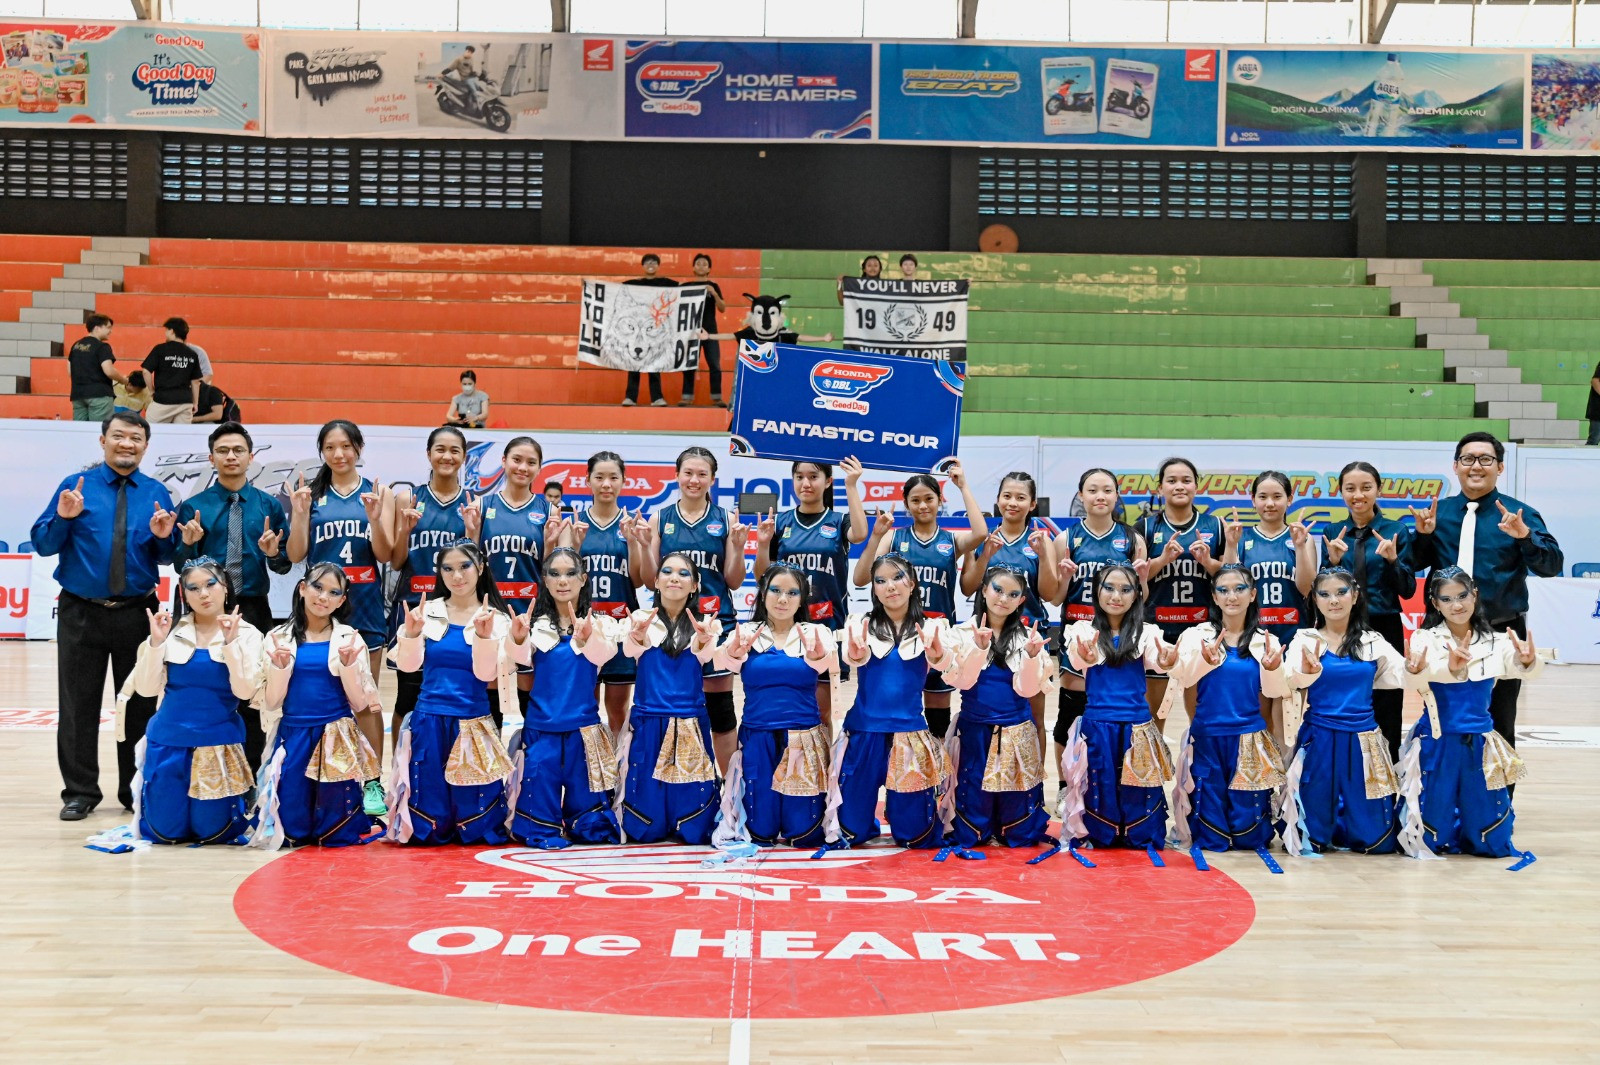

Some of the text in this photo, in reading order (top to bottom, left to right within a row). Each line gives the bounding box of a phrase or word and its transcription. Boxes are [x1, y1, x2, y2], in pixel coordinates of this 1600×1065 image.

[155, 34, 182, 46] Good
[183, 36, 204, 50] Day
[153, 53, 171, 65] It's
[288, 60, 304, 69] PAKE
[137, 63, 215, 84] Good Day
[1236, 63, 1258, 73] AQUA
[307, 74, 325, 85] GAYA
[325, 72, 348, 83] MAKIN
[659, 81, 680, 91] DBL
[725, 74, 794, 87] HOME
[153, 81, 200, 100] Time!
[725, 88, 858, 101] DREAMERS
[1376, 82, 1400, 96] AQUA
[662, 102, 682, 111] Good
[682, 103, 699, 113] Day
[1271, 105, 1486, 117] DINGIN ALAMINYA ADEMIN KAMU
[857, 278, 957, 294] YOU'LL NEVER
[855, 307, 956, 332] 19 49
[833, 369, 873, 379] HONDA
[831, 380, 851, 391] DBL
[832, 400, 852, 410] Good
[852, 402, 868, 413] Day
[752, 418, 939, 450] FANTASTIC FOUR
[869, 486, 894, 498] OF
[315, 519, 372, 544] LOYOLA
[339, 541, 353, 564] 4
[484, 534, 539, 561] LOYOLA
[504, 556, 517, 579] 7
[582, 554, 629, 578] OYOLA
[914, 565, 948, 589] YOLA
[591, 575, 611, 599] 19
[1172, 580, 1194, 604] 12
[1262, 582, 1283, 605] 18
[445, 880, 1042, 904] HONDA
[407, 926, 1081, 962] One HEART.
